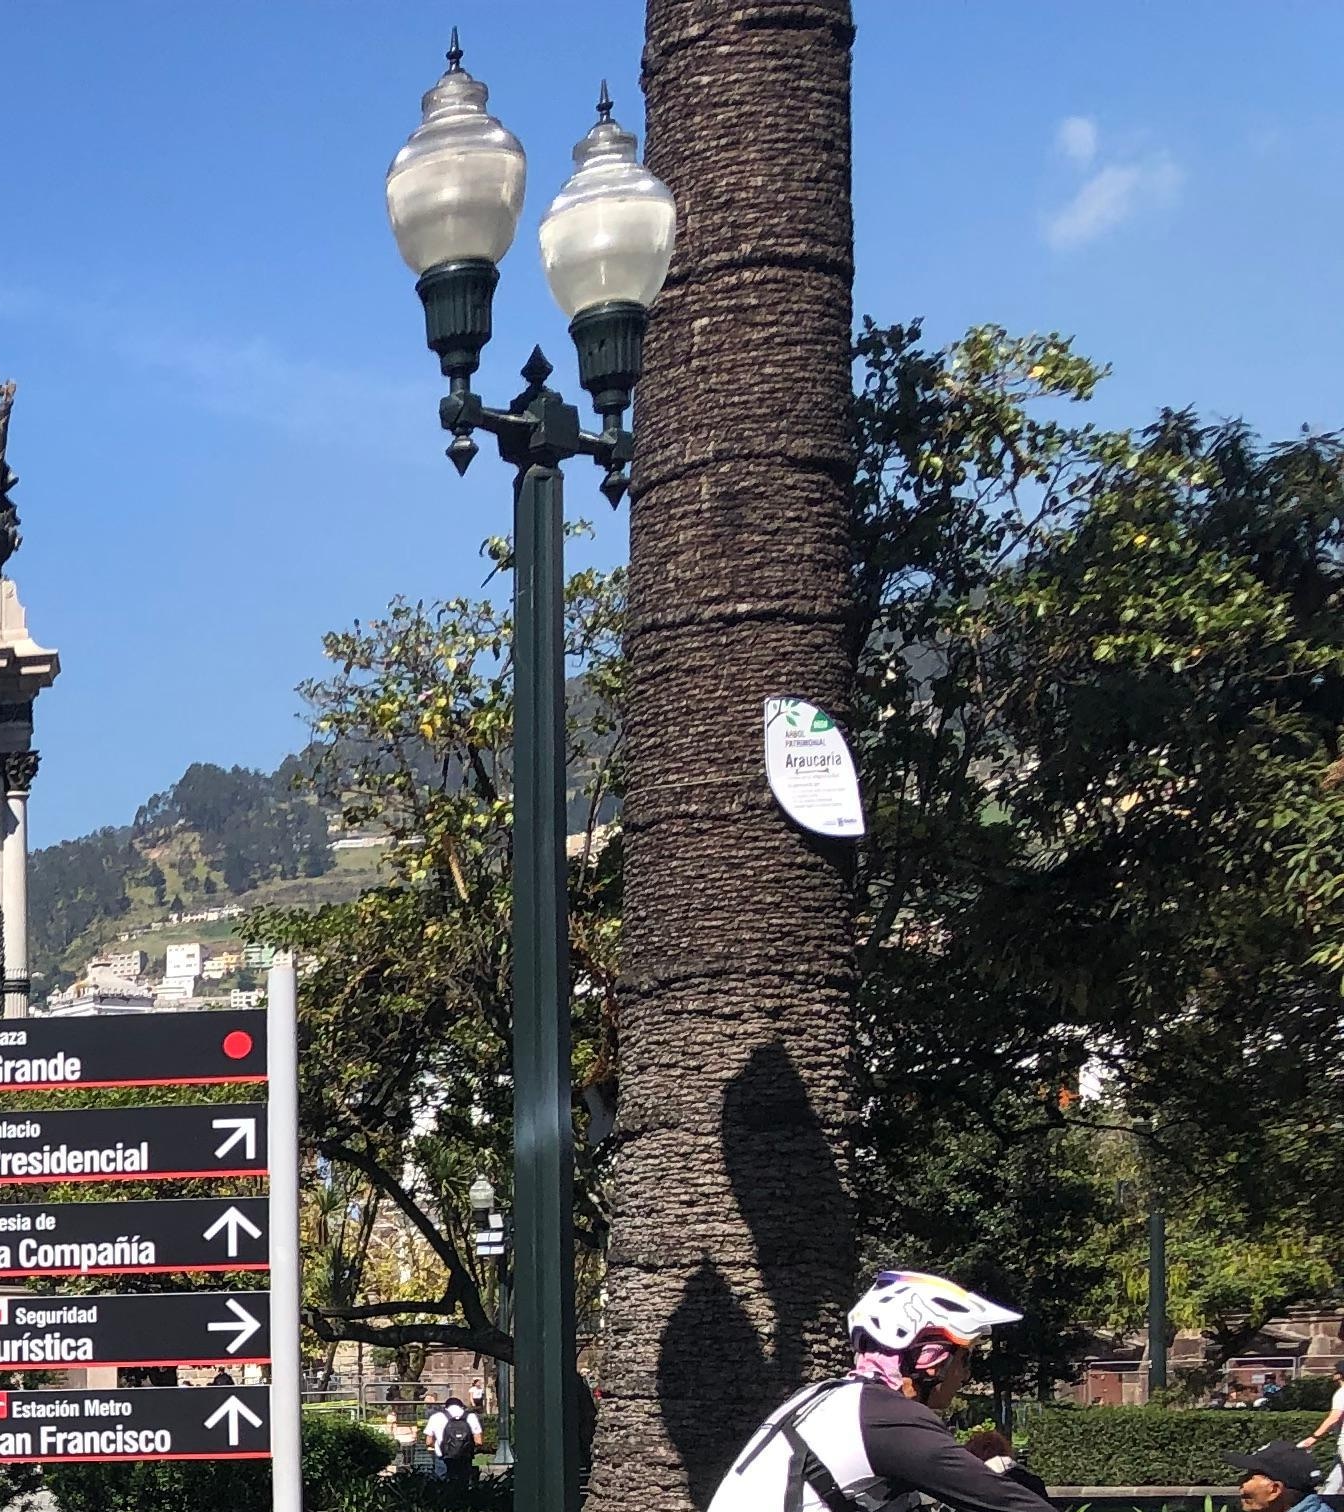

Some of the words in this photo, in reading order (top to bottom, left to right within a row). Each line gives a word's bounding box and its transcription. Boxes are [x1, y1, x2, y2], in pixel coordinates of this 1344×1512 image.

[785, 752, 842, 768] Araucaria
[35, 1212, 56, 1231] de
[18, 1235, 156, 1271] Compañía
[15, 1305, 98, 1327] Seguridad
[11, 1399, 80, 1419] Estación
[84, 1399, 132, 1417] Metro
[40, 1424, 172, 1455] Francisco
